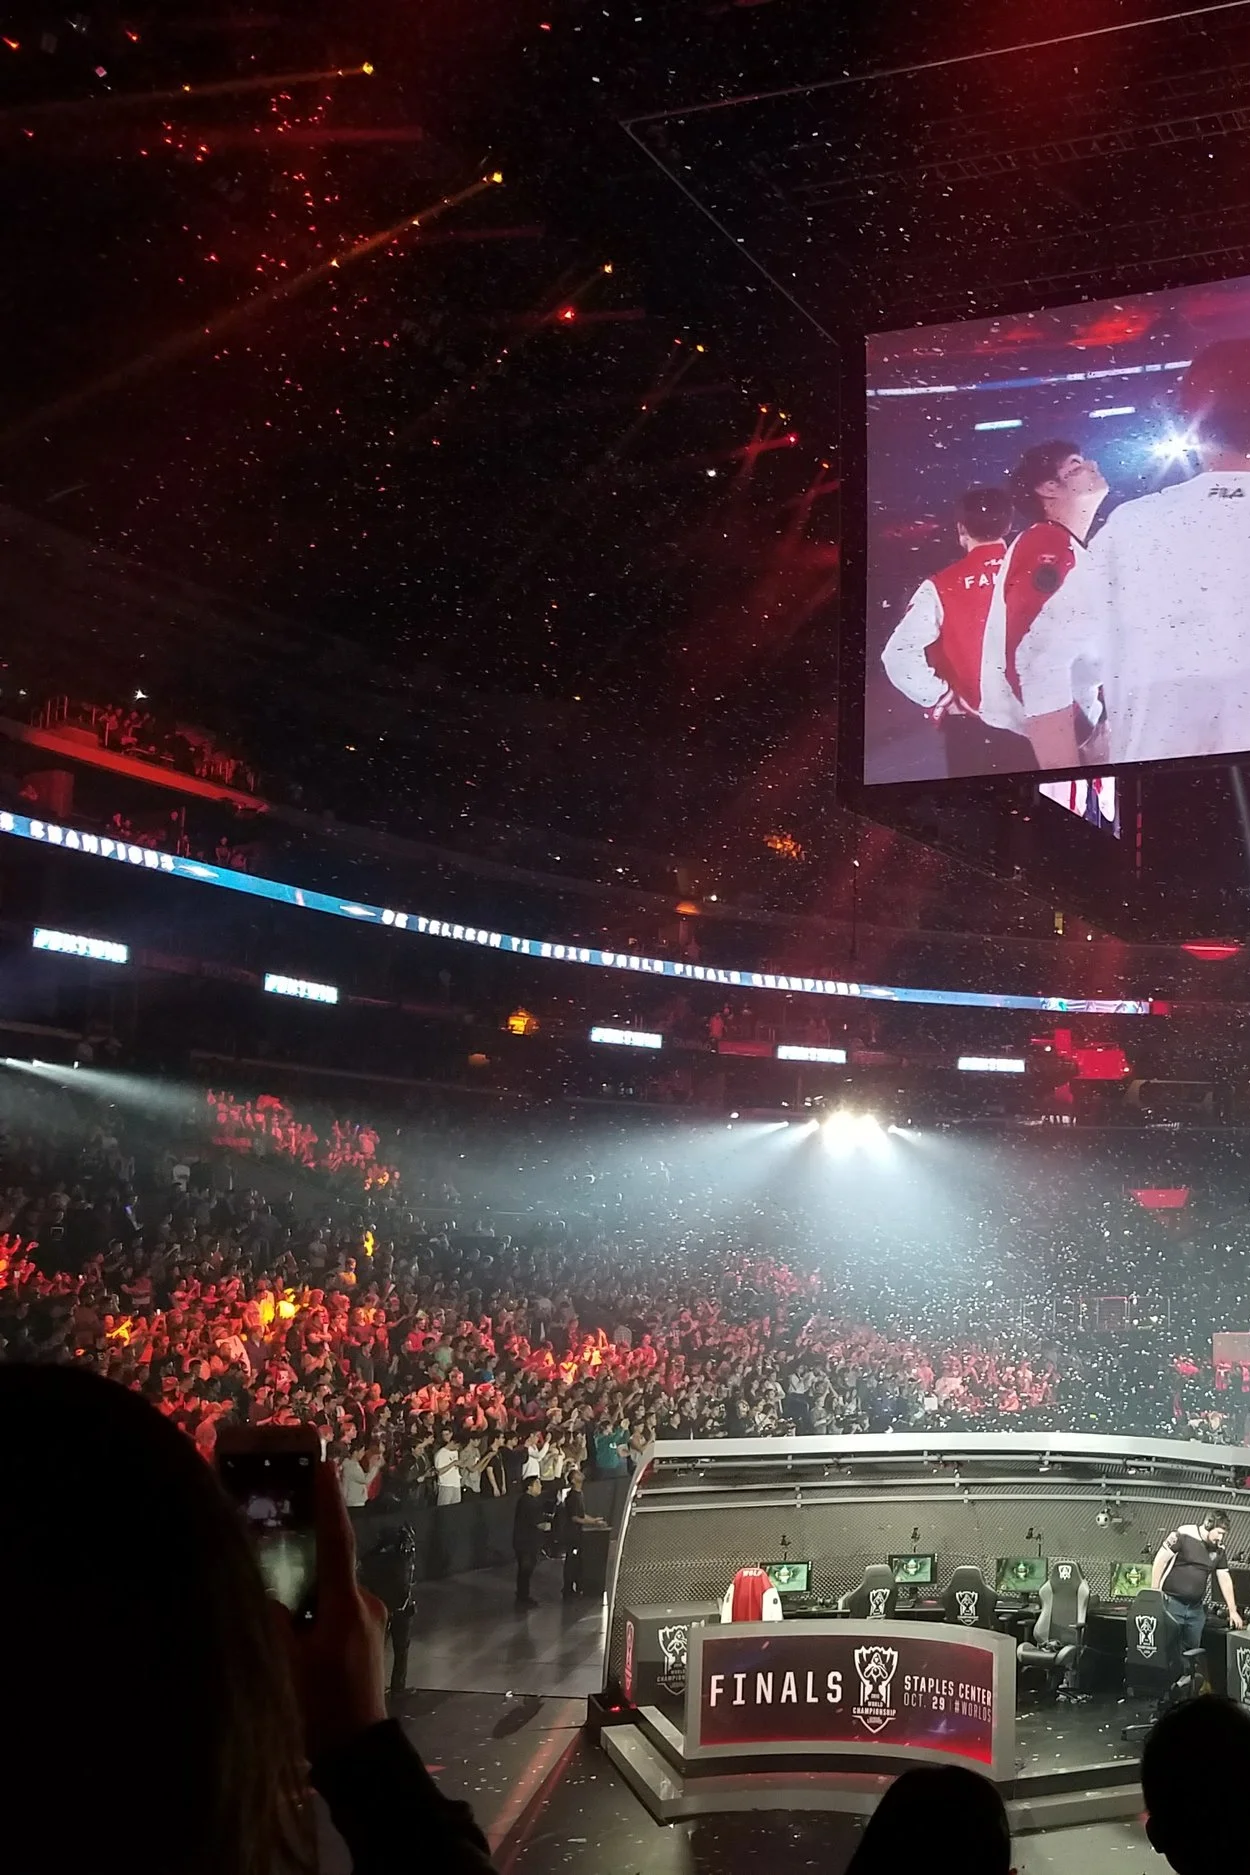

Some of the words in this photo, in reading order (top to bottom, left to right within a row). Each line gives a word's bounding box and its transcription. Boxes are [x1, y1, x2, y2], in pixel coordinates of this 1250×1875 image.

[709, 1671, 843, 1707] FINALS
[904, 1675, 955, 1697] STAPLES
[958, 1683, 992, 1707] CENTER
[852, 1706, 897, 1717] CHAMPIONSHIP
[903, 1692, 927, 1709] OCT.
[932, 1696, 946, 1711] 29
[954, 1699, 992, 1723] #WORLDS
